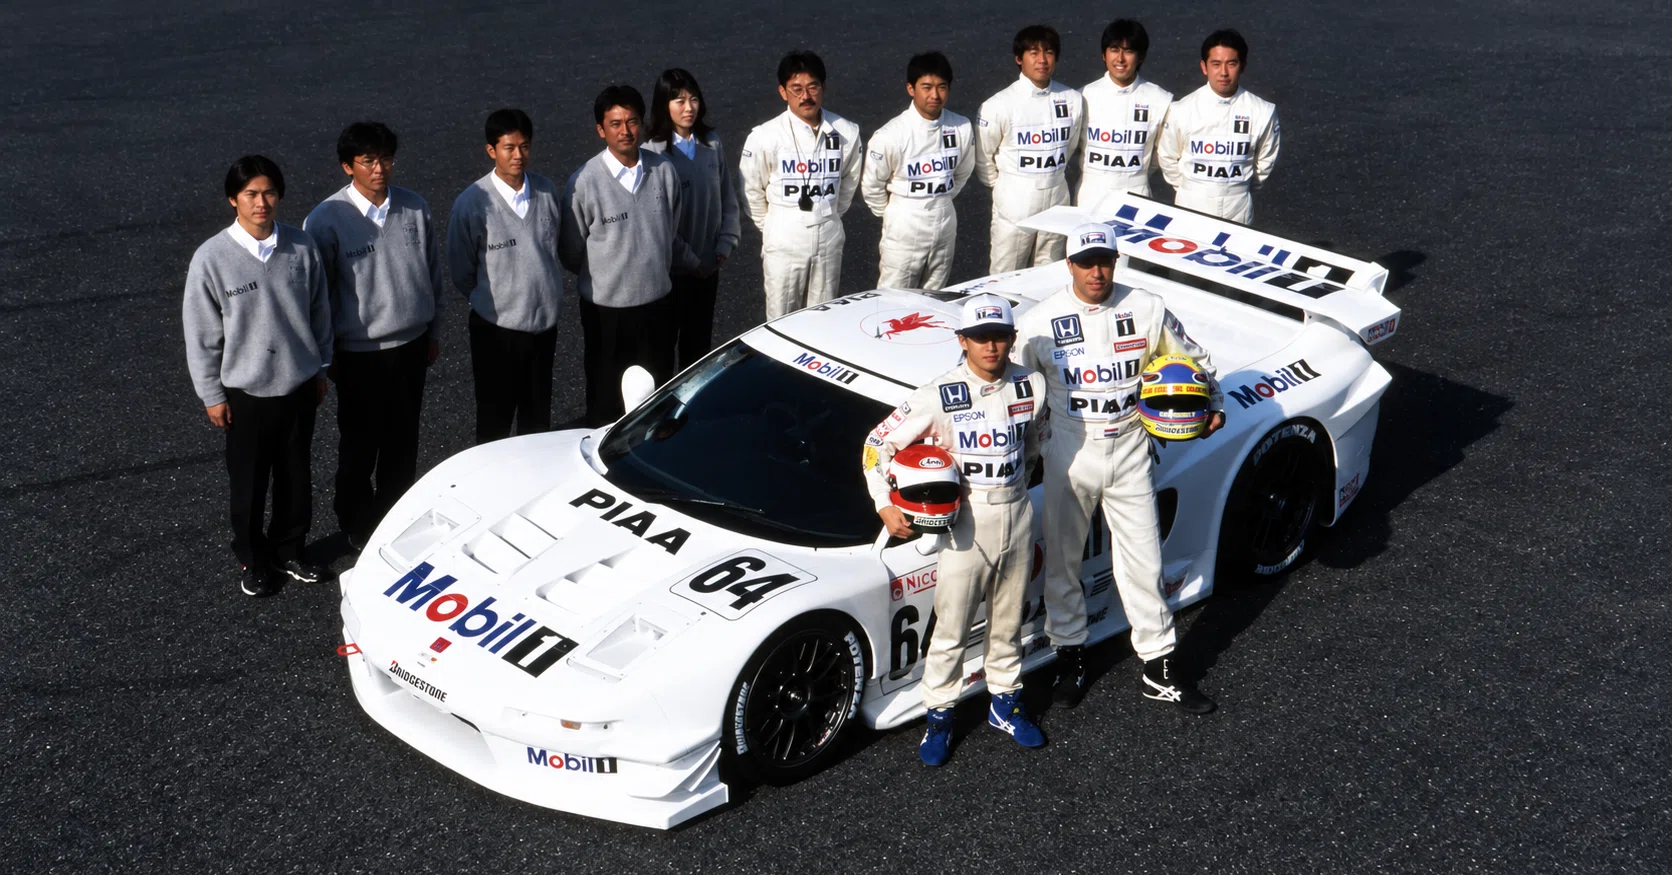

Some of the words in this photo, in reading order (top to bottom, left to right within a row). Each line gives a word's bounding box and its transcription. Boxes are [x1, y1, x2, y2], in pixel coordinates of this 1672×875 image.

[1020, 153, 1066, 169] PIAA
[1089, 152, 1141, 168] PIAA
[1193, 163, 1242, 178] PIAA
[910, 178, 954, 194] PIAA
[1053, 347, 1085, 360] EPSON
[1070, 394, 1138, 414] PIAA
[953, 410, 986, 423] EPSON
[568, 487, 692, 556] PIAA
[689, 556, 801, 611] 64
[389, 660, 448, 703] BRIDGESTONE
